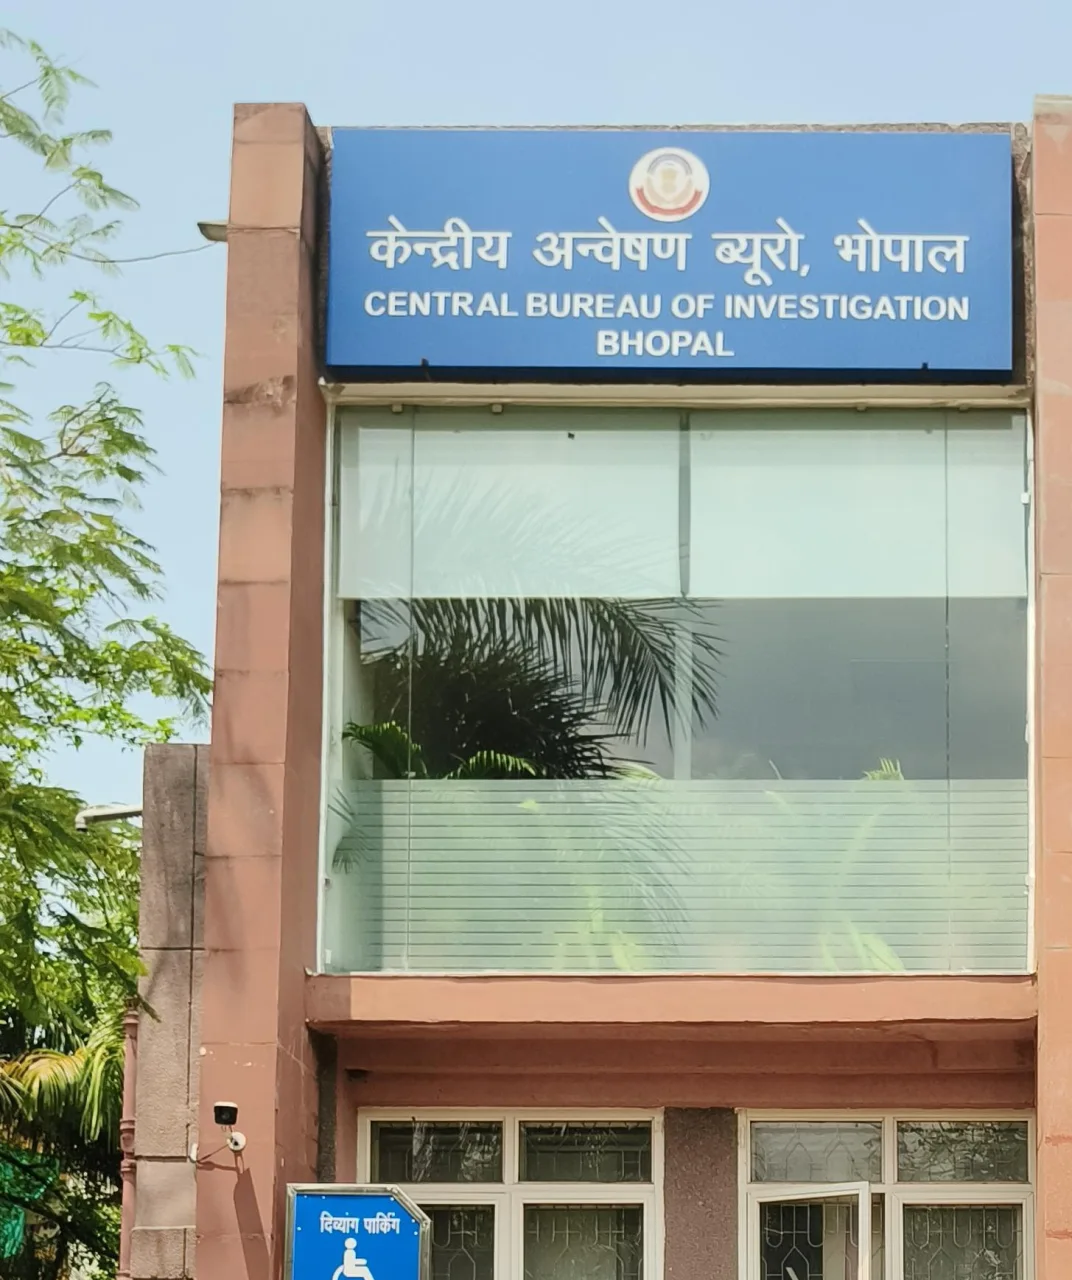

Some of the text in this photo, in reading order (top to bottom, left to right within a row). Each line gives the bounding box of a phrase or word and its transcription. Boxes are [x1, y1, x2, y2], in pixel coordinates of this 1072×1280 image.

[365, 215, 970, 286] केन्द्रीय अन्वेषण ब्यूरो, भोपाल
[364, 291, 969, 321] CENTRAL BUREAU OF INVESTIGATION
[597, 330, 734, 357] BHOPAL
[320, 1210, 401, 1234] दिव्यांग पार्किंग
